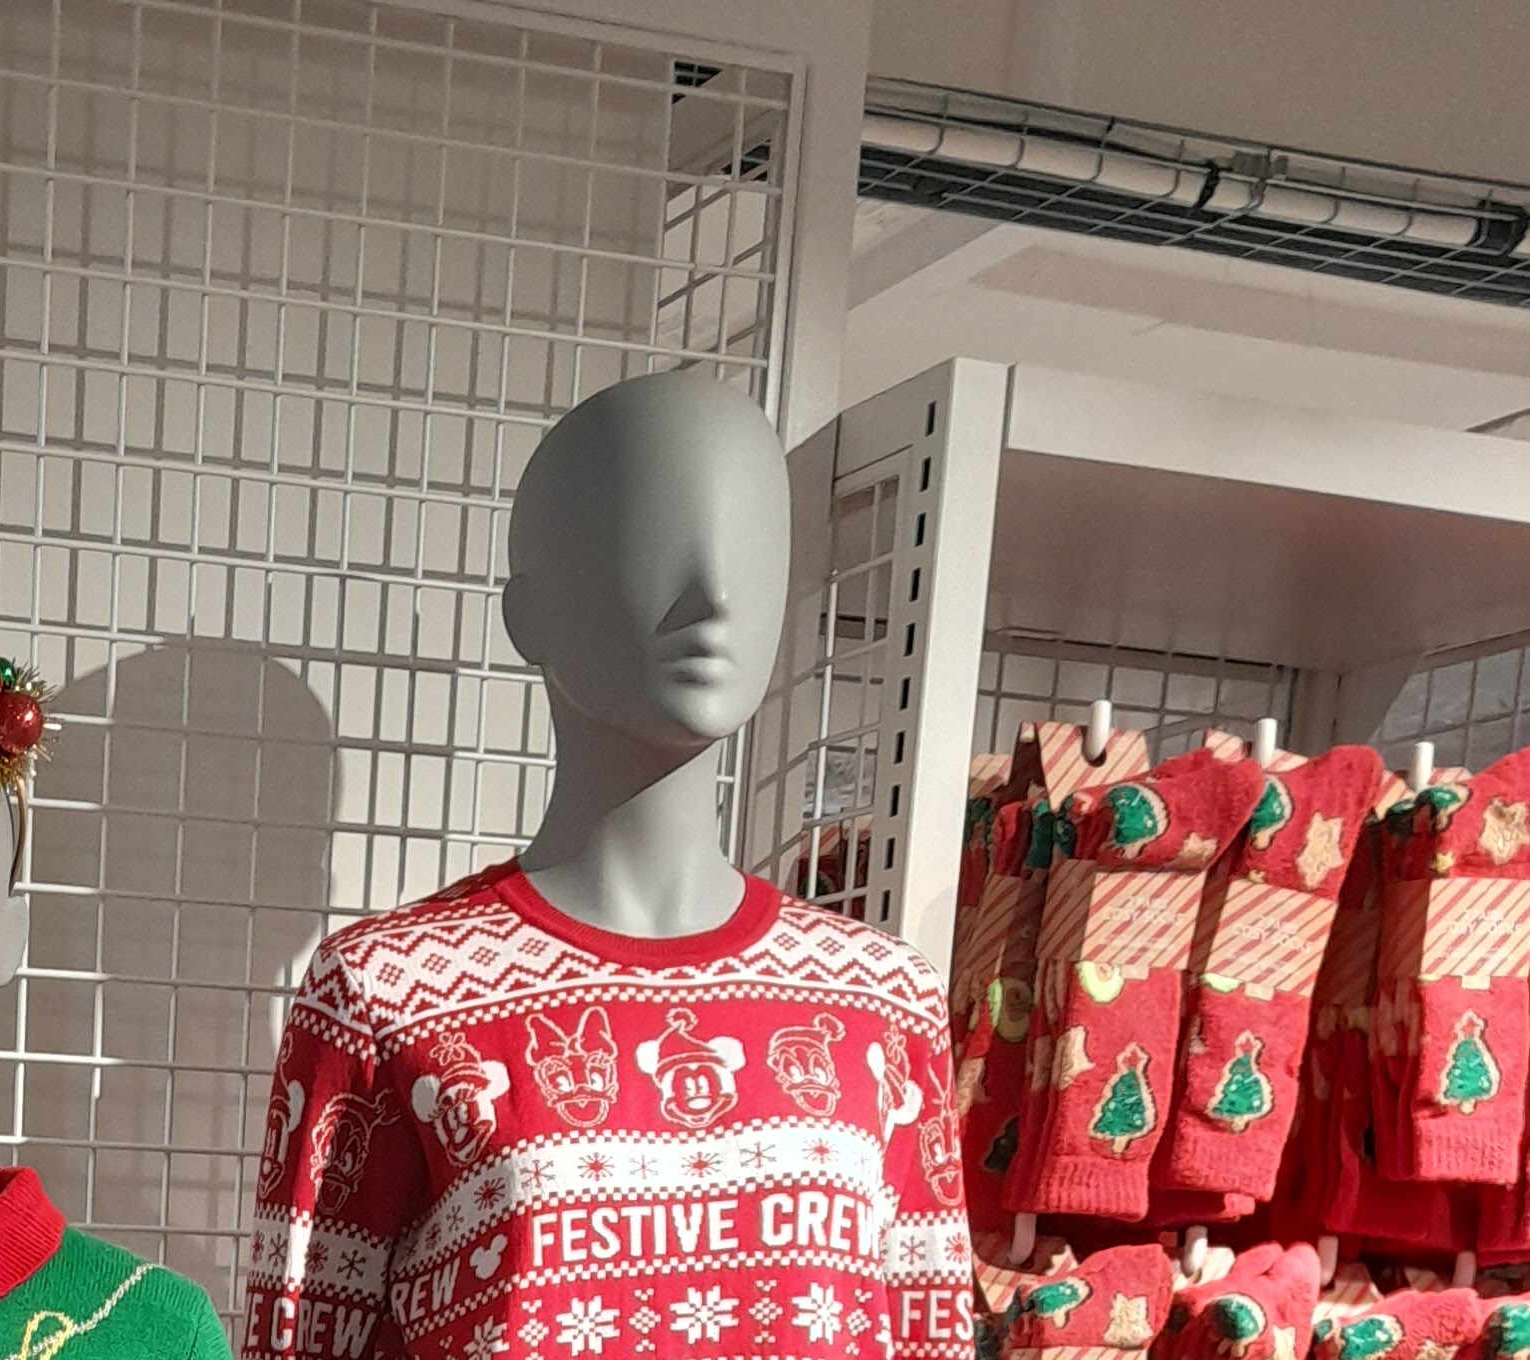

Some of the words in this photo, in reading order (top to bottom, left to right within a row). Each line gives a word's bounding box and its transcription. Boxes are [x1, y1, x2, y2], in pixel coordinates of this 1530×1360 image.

[531, 1199, 739, 1267] FESTIVE
[390, 1256, 462, 1326] REW
[270, 1297, 376, 1360] CREW
